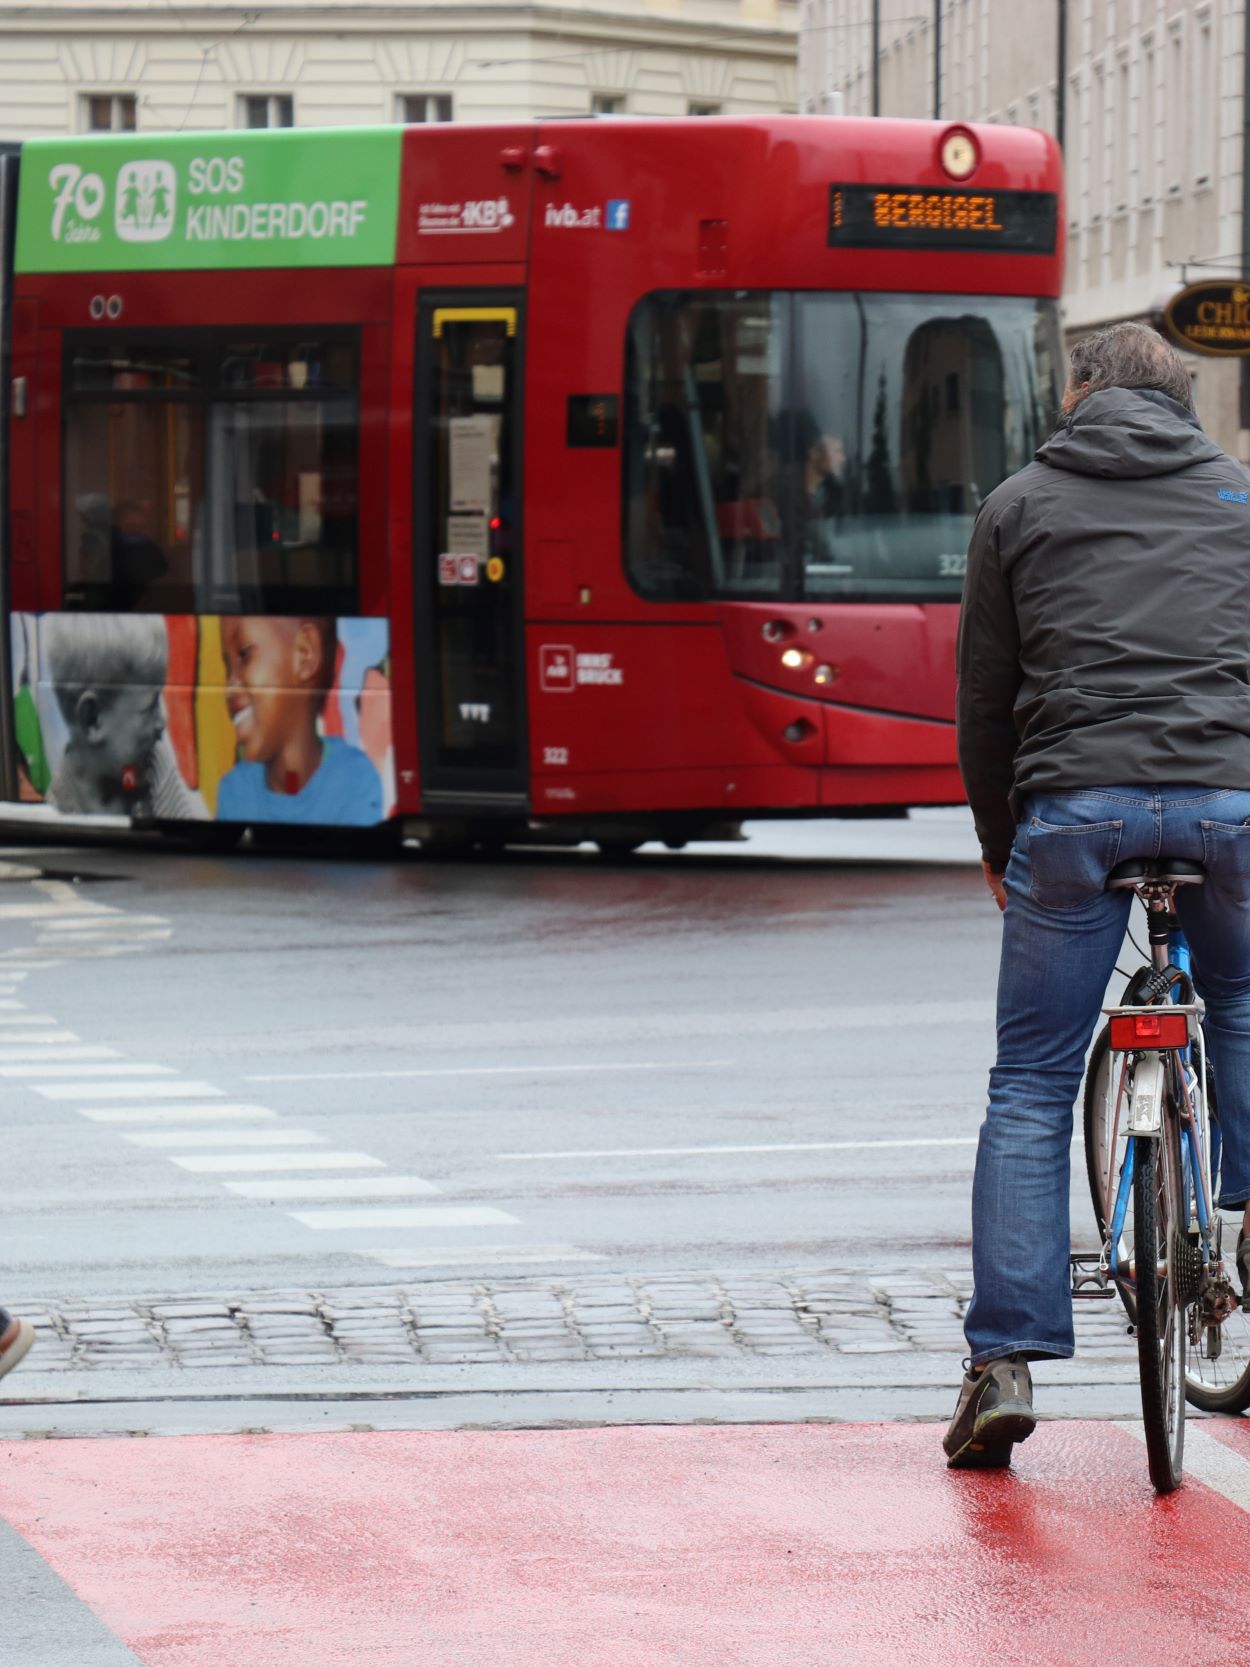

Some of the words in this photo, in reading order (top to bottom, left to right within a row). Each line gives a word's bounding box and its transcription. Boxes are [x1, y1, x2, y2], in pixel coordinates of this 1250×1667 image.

[187, 157, 245, 195] SOS
[48, 163, 105, 241] 70
[184, 200, 368, 241] KINDERDORF
[544, 202, 600, 228] ivb.at
